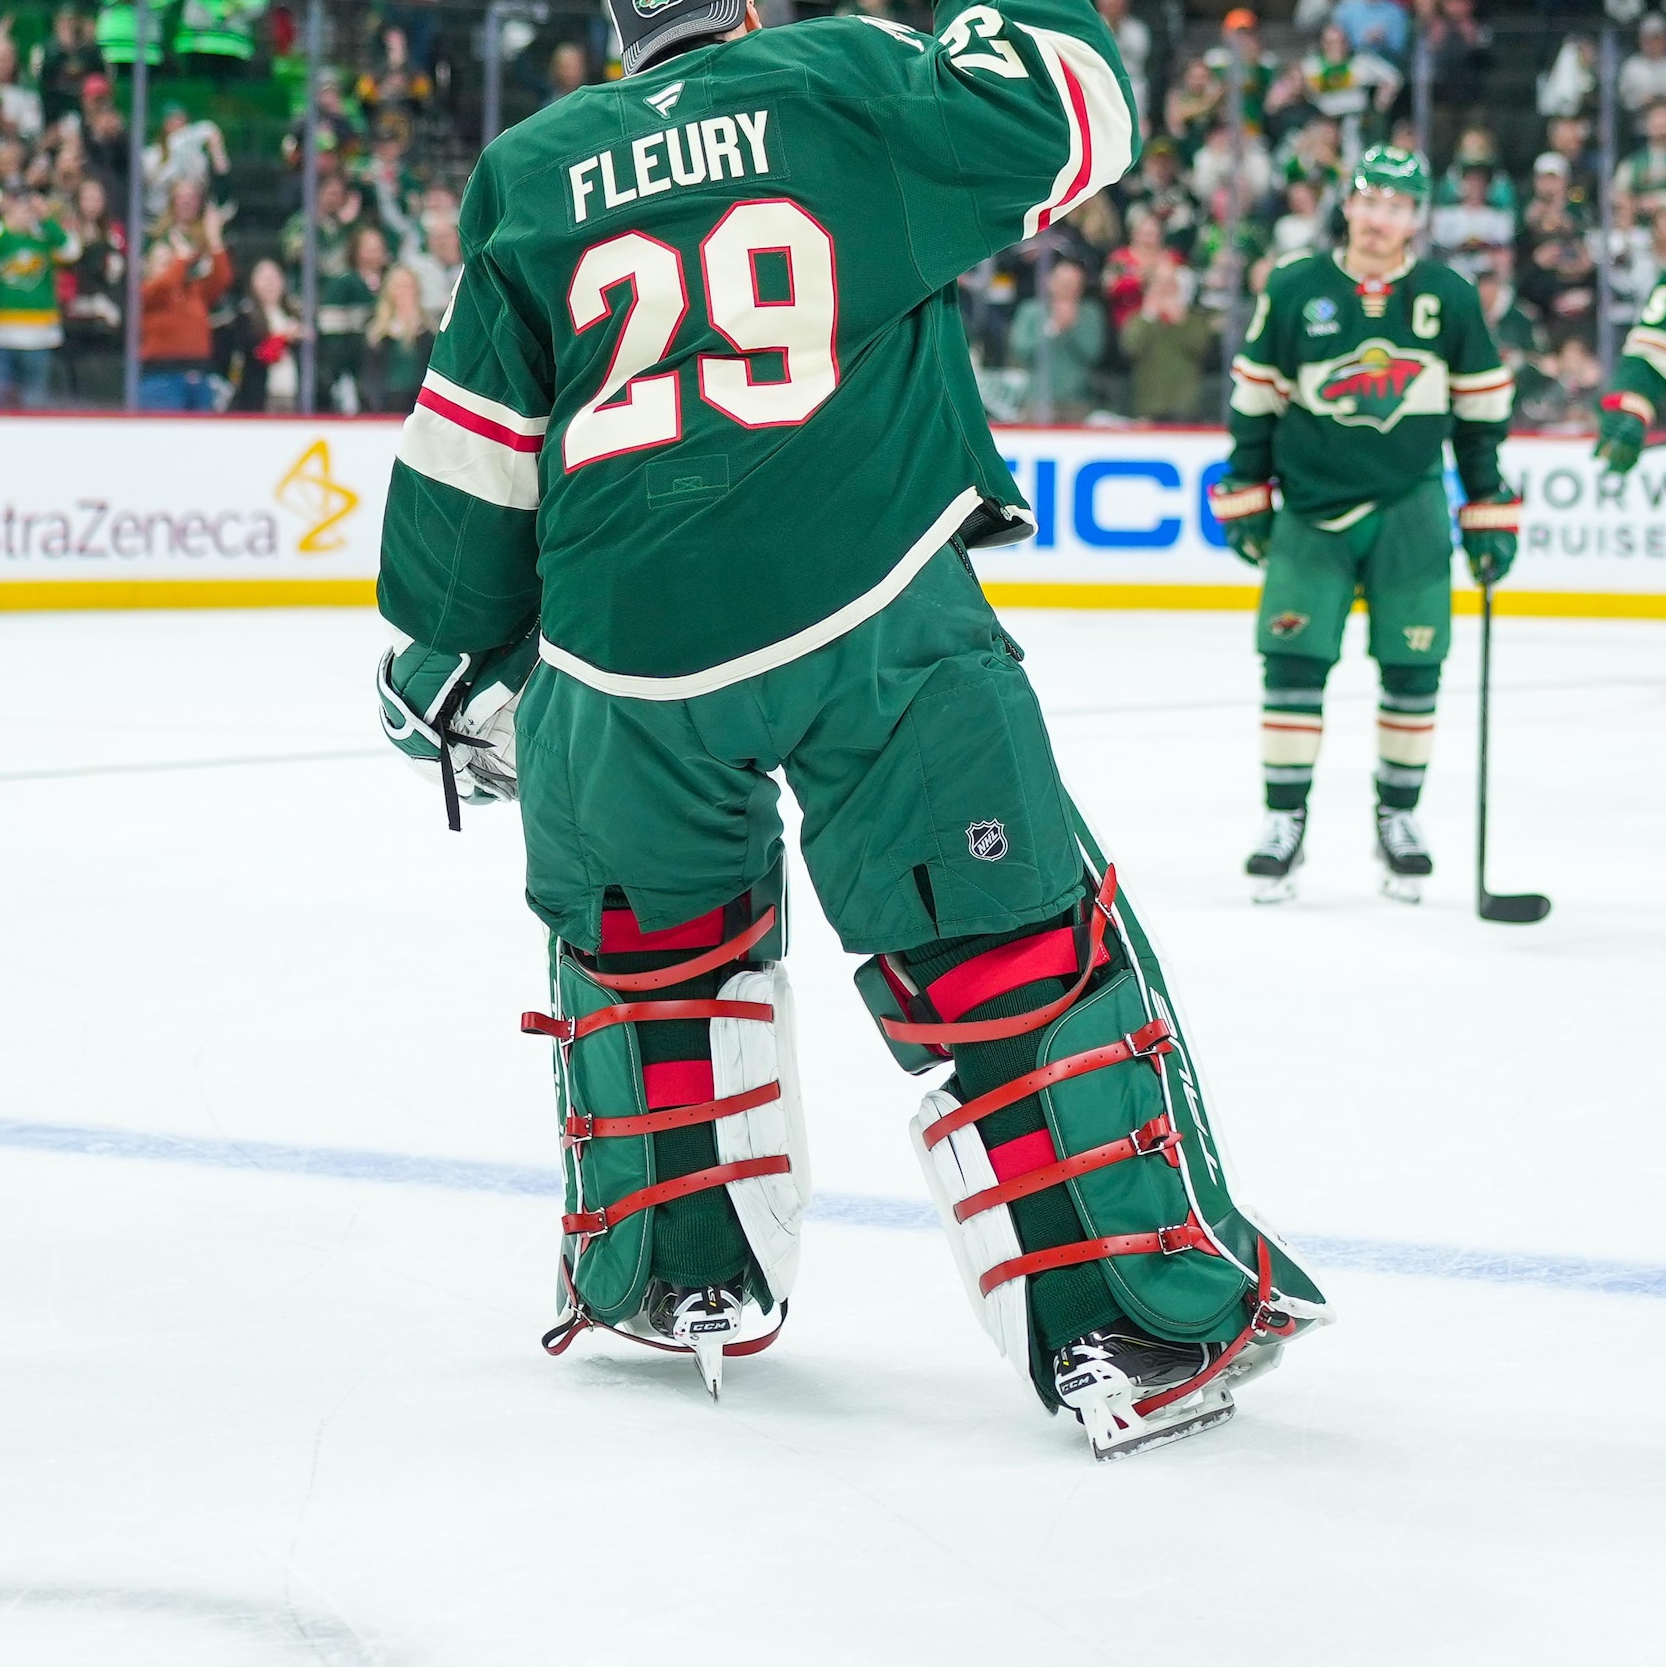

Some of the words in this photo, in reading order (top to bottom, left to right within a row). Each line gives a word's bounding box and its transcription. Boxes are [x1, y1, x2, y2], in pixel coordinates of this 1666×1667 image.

[570, 110, 769, 224] FLEURY
[1412, 293, 1441, 339] C
[563, 197, 839, 475] 29
[1526, 525, 1666, 559] RUISE
[977, 830, 999, 855] NHL
[693, 1321, 727, 1331] CCM
[1061, 1375, 1091, 1393] CCM
